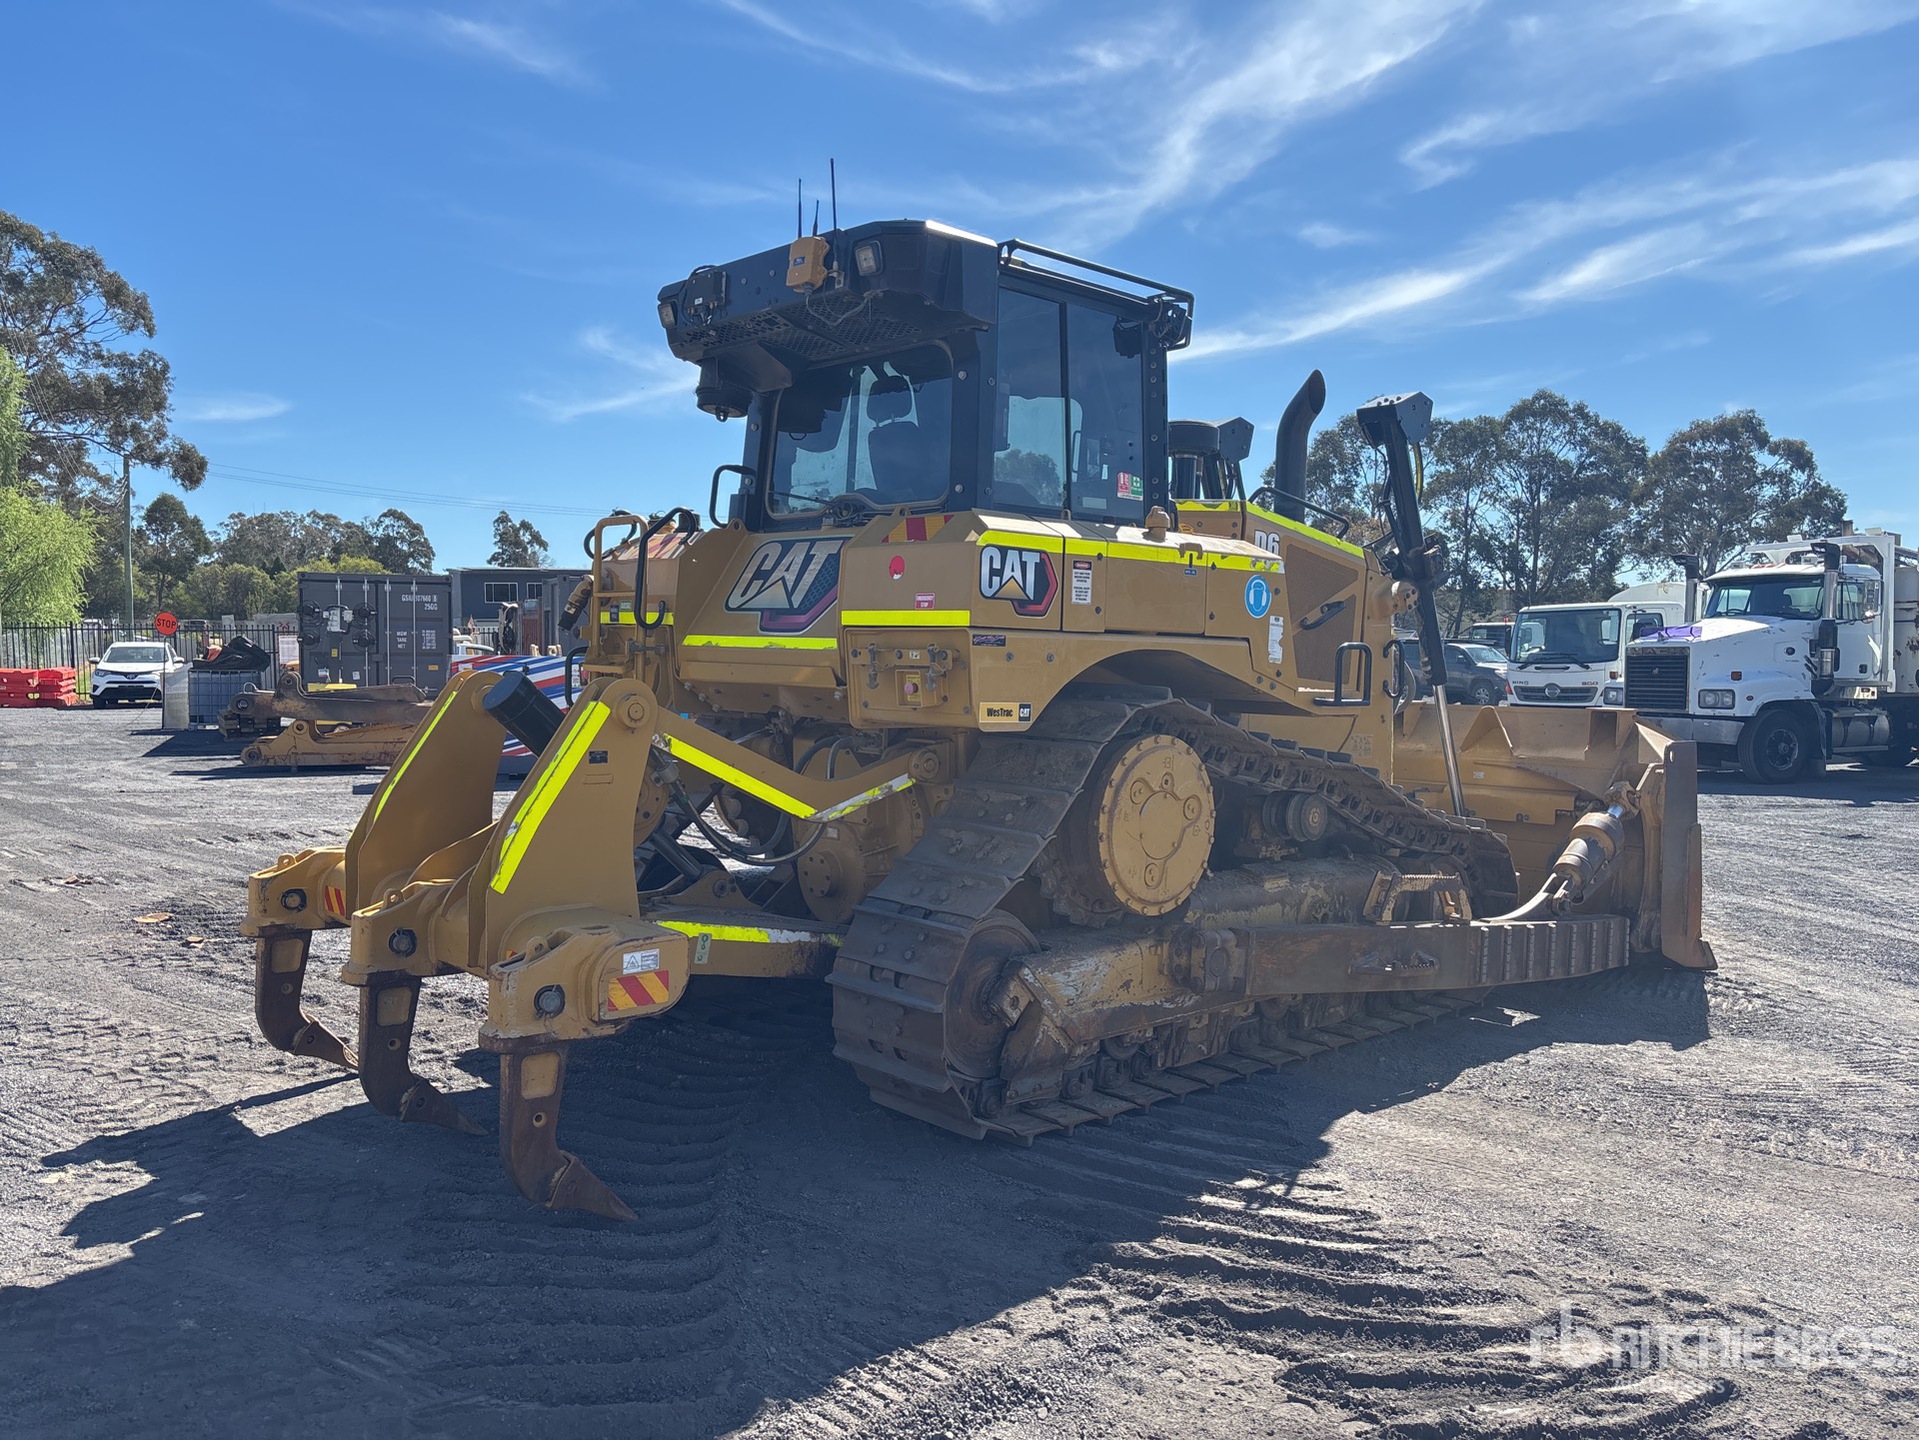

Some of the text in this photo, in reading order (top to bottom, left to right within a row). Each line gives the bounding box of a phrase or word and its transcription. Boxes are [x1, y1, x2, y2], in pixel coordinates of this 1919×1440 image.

[728, 540, 844, 609] CAT
[981, 546, 1041, 601] CAT
[156, 618, 177, 629] STOP
[986, 707, 1014, 718] WesTrac
